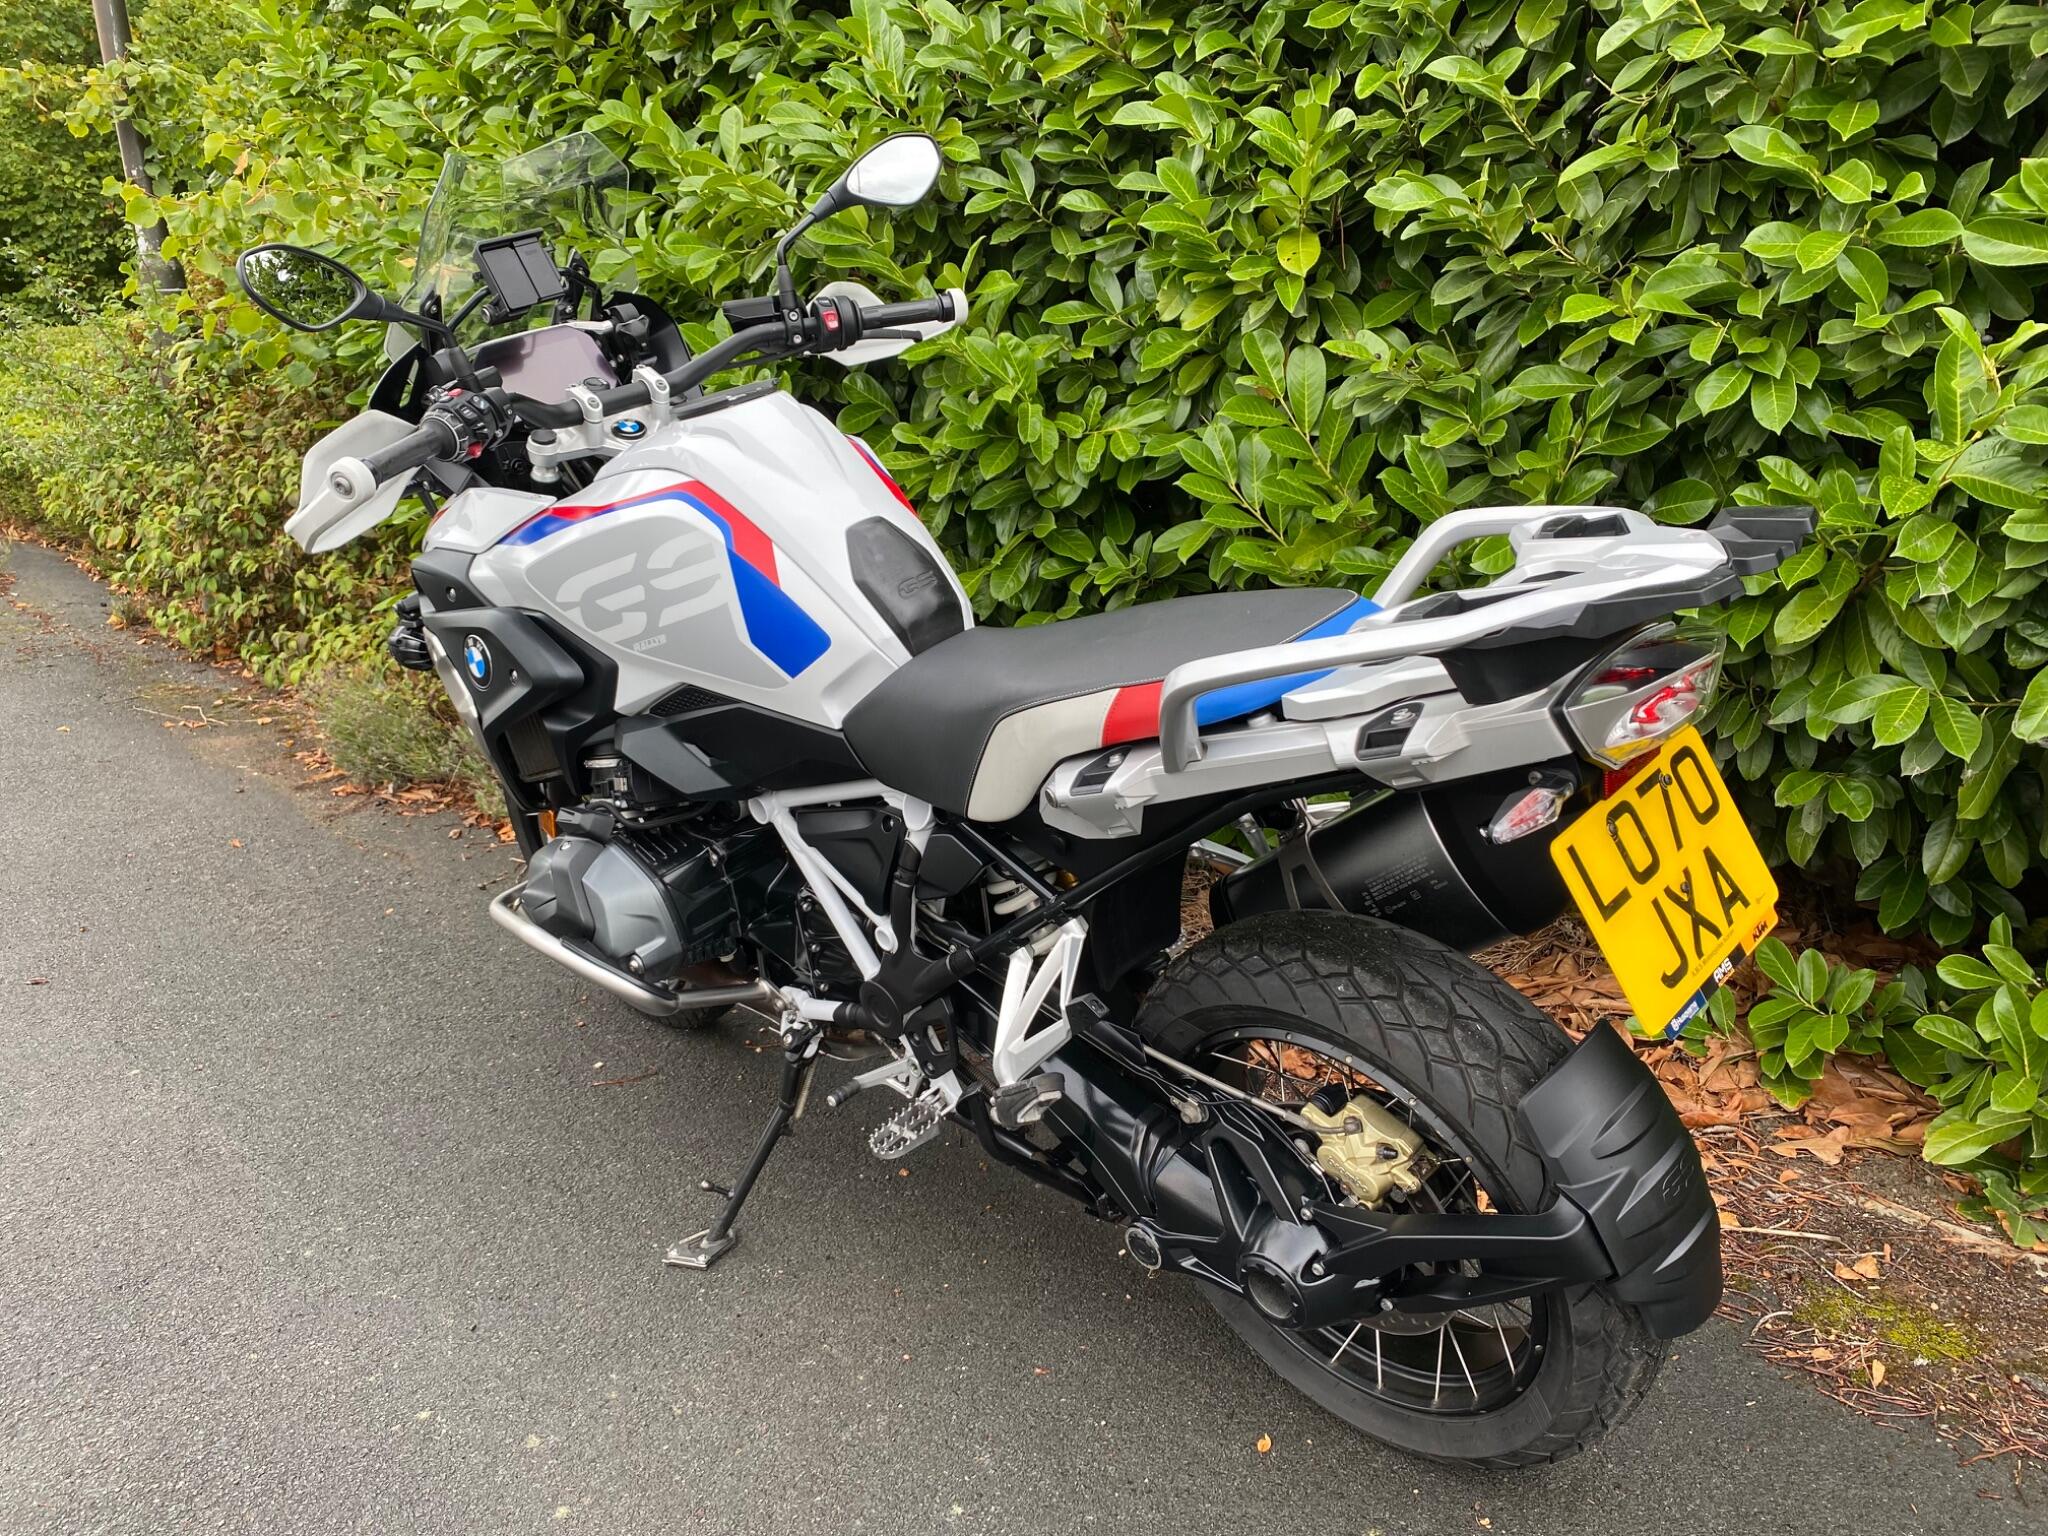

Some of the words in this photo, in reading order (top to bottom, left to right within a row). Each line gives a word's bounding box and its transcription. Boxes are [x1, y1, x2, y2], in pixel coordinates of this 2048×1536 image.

[556, 530, 724, 643] GS
[1567, 745, 1720, 923] LO70
[1651, 846, 1751, 990] JXA
[1713, 957, 1733, 983] AMS
[1752, 920, 1769, 941] KTM
